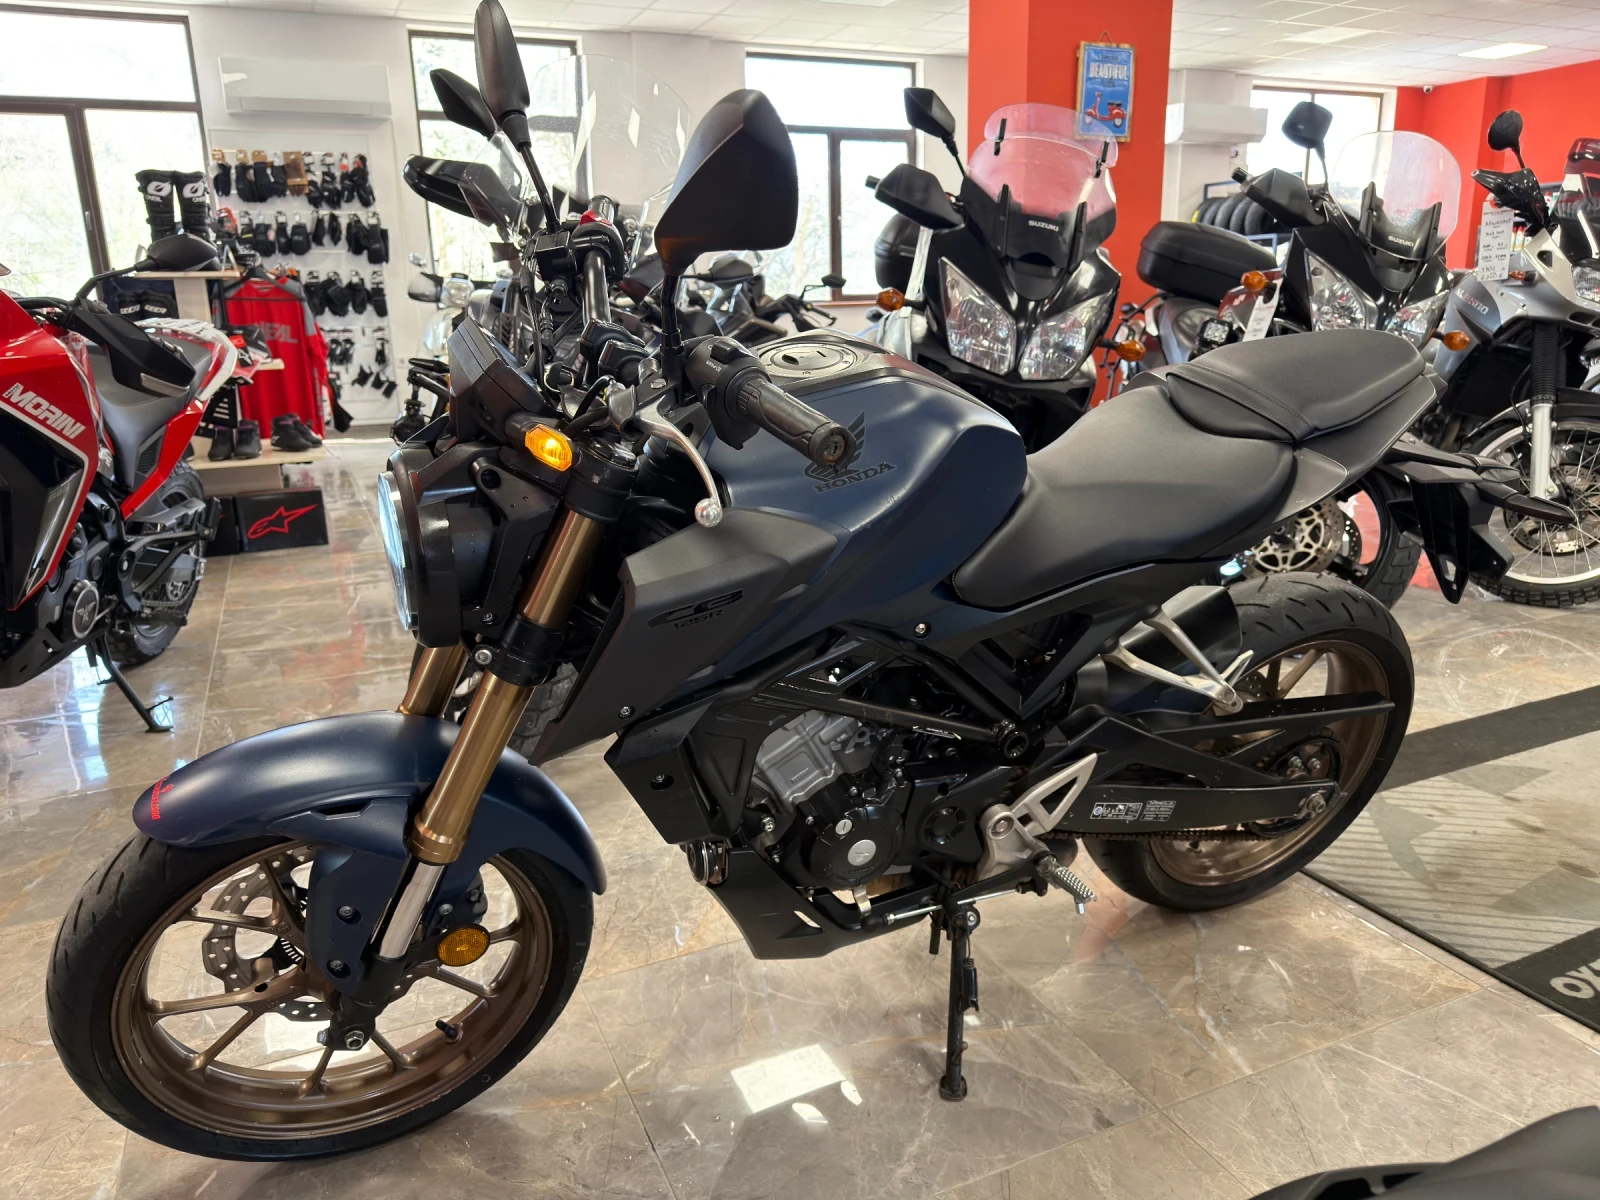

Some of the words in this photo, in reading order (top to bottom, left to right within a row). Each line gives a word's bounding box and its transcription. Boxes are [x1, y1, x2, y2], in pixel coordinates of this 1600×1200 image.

[1089, 62, 1128, 80] BEAUTIFUL
[1028, 220, 1059, 232] SUZUKI
[1388, 235, 1414, 247] SUZUKI
[9, 384, 86, 440] MORINI
[814, 462, 896, 492] HONDA
[1549, 958, 1600, 999] OX
